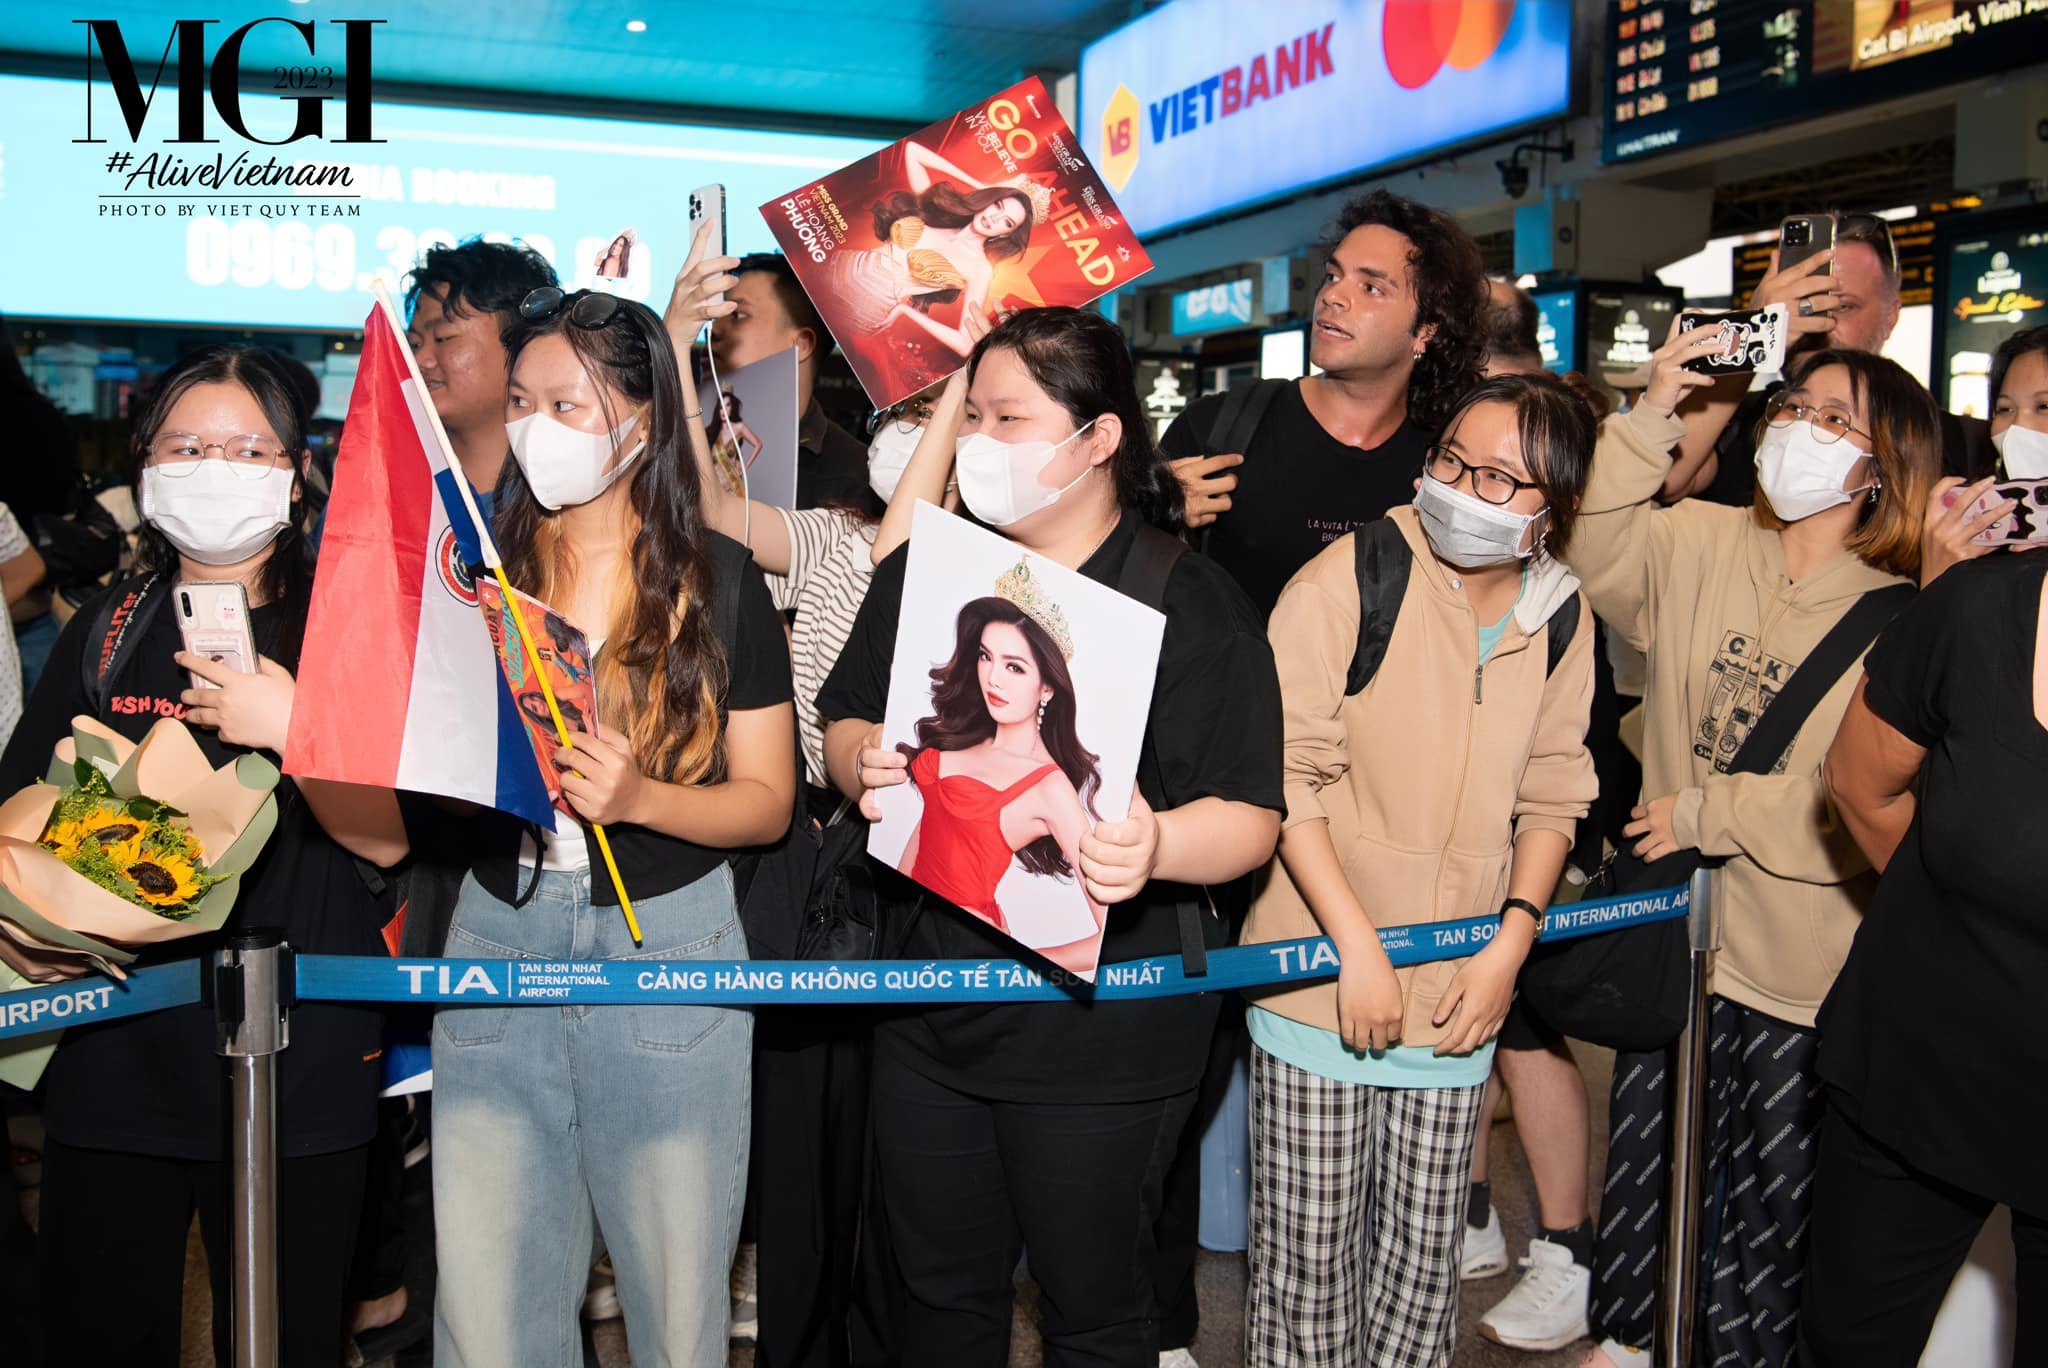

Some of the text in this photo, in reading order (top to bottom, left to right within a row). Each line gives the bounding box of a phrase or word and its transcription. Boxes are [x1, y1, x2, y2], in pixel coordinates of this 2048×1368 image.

[1857, 37, 1887, 61] Cat
[1149, 21, 1336, 145] VIETBANK
[965, 115, 993, 154] IN YOU
[974, 110, 1018, 174] WE BELIEVE
[809, 189, 834, 225] VIETNAM
[817, 184, 848, 231] MISS GRAND
[988, 99, 1115, 286] GO AHEAD
[780, 198, 826, 263] PHƯƠNG
[795, 193, 834, 250] LÊ HOÀNG
[1322, 521, 1343, 530] VITA
[1555, 896, 1669, 929] INTERNATIONAL
[1388, 928, 1409, 940] NHAT
[1433, 928, 1466, 948] TAN
[518, 964, 603, 974] TAN SON NHAT
[1270, 943, 1341, 974] TIA
[397, 965, 499, 995] TIA
[518, 975, 610, 985] INTERNATIONAL
[637, 965, 707, 990] CẢNG
[715, 967, 783, 990] HÀNG
[792, 966, 877, 990] KHÔNG
[884, 963, 953, 989] QUỐC
[960, 963, 991, 988] TẾ
[996, 964, 1042, 988] TÂN
[518, 988, 571, 998] AIRPORT
